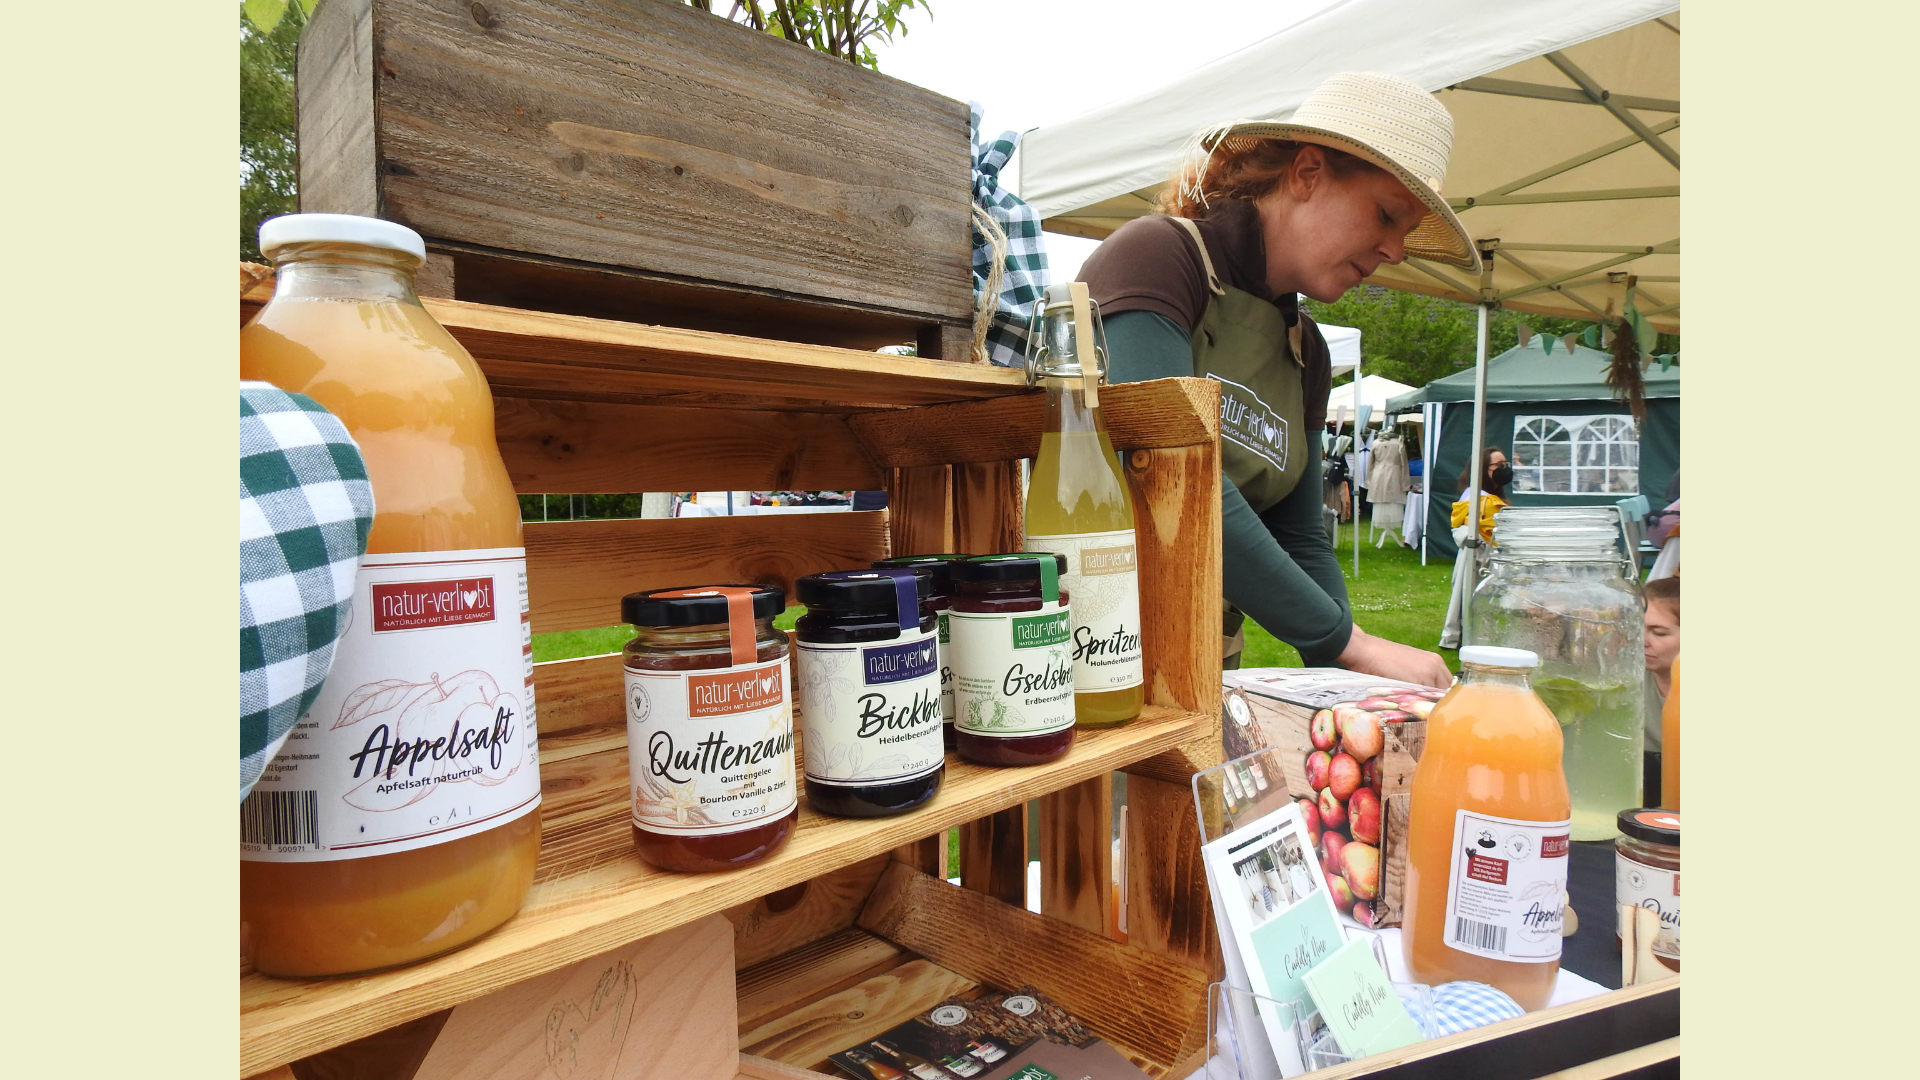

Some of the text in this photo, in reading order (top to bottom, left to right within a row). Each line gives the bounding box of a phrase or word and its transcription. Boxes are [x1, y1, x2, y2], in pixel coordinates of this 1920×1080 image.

[383, 618, 426, 627] NATÜRLICH
[444, 613, 462, 622] LIEBE
[464, 611, 491, 620] GEMACHT
[696, 705, 732, 714] NATÜRLICH
[733, 703, 744, 711] MIT
[349, 706, 515, 780] Appelsaft
[911, 760, 924, 770] 240
[376, 766, 483, 794] Apfelsaft naturtrüb
[720, 768, 772, 784] Quittengelee
[700, 794, 738, 804] Bourbon
[739, 789, 766, 799] Vanille
[773, 780, 786, 791] Zimt
[743, 781, 756, 789] mit
[742, 807, 759, 816] 220
[761, 804, 766, 815] g
[278, 845, 305, 853] 500971
